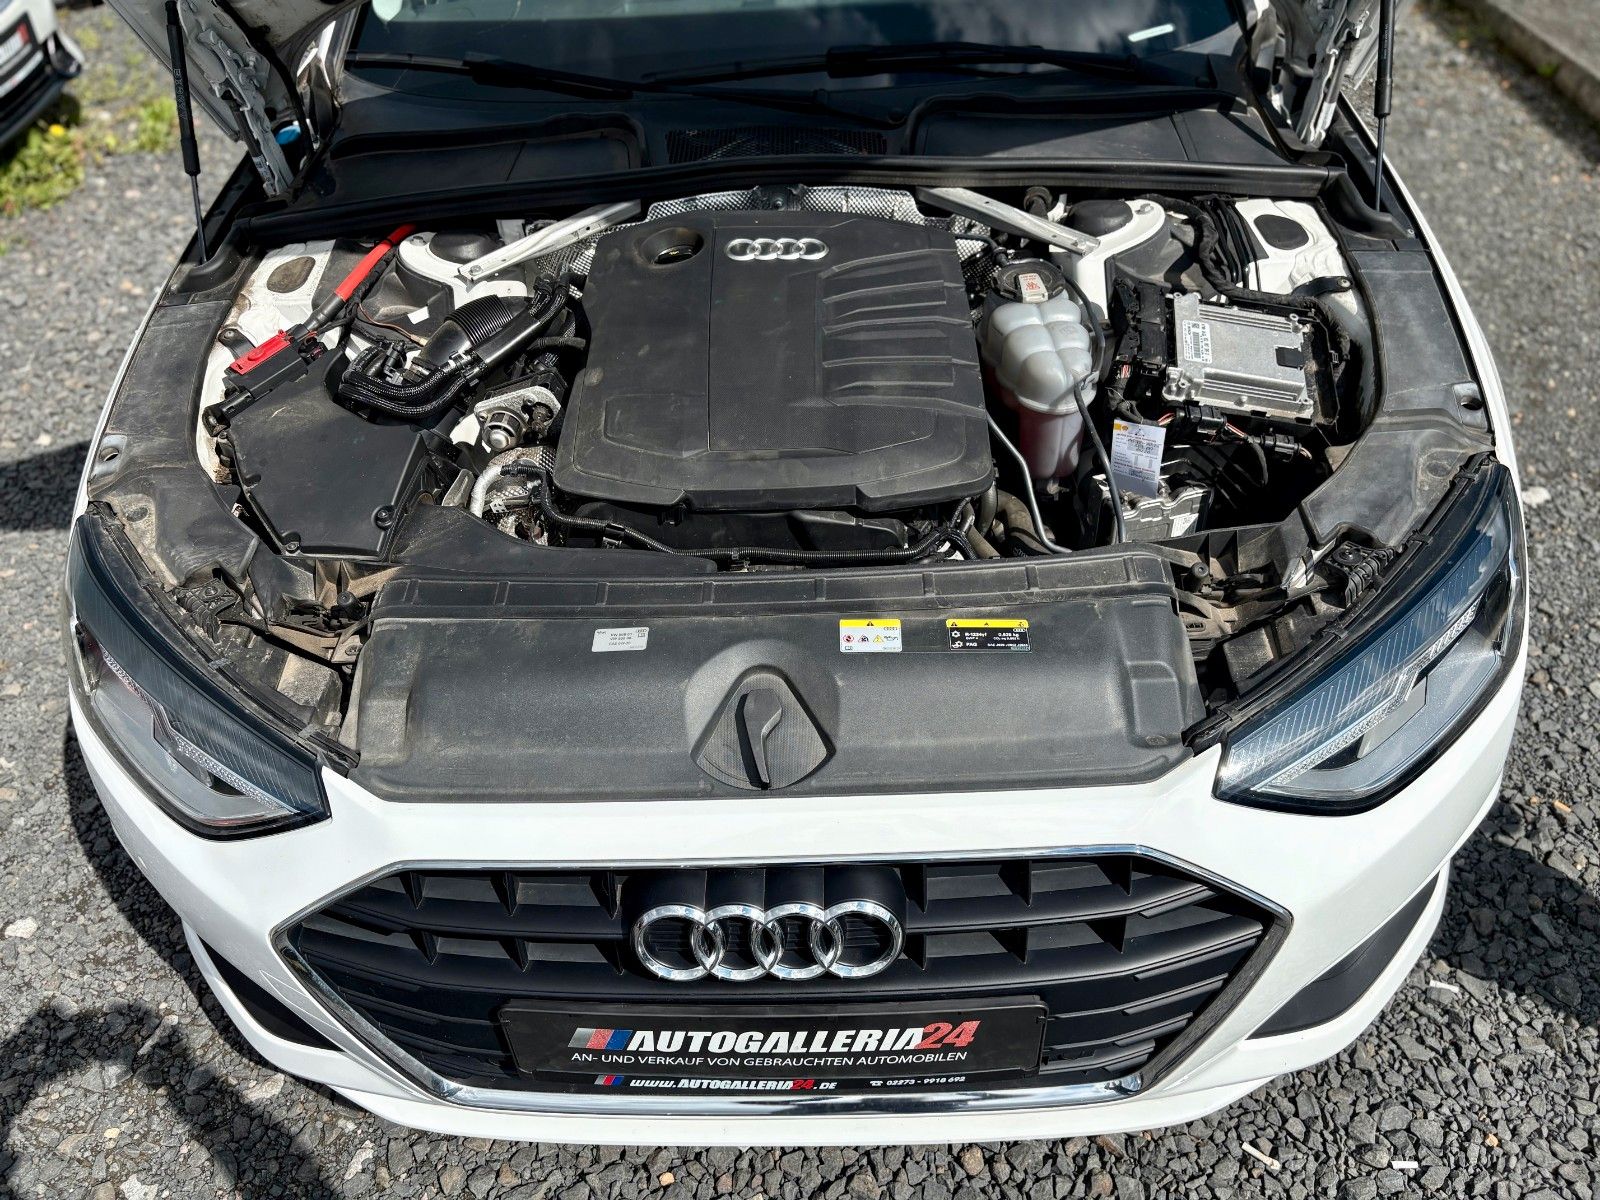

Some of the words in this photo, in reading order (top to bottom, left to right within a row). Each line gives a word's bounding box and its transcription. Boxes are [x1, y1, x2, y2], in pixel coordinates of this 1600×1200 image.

[626, 1020, 981, 1054] AUTOGALLERIA24
[571, 1053, 598, 1062] AN-
[601, 1054, 635, 1064] UND
[638, 1056, 704, 1066] VERKAUF
[707, 1057, 741, 1066] VON
[743, 1056, 852, 1067] GEBRAUCHTEN
[856, 1051, 968, 1066] AUTOMOBILEN
[886, 1078, 916, 1086] 02273
[923, 1077, 946, 1085] 9918
